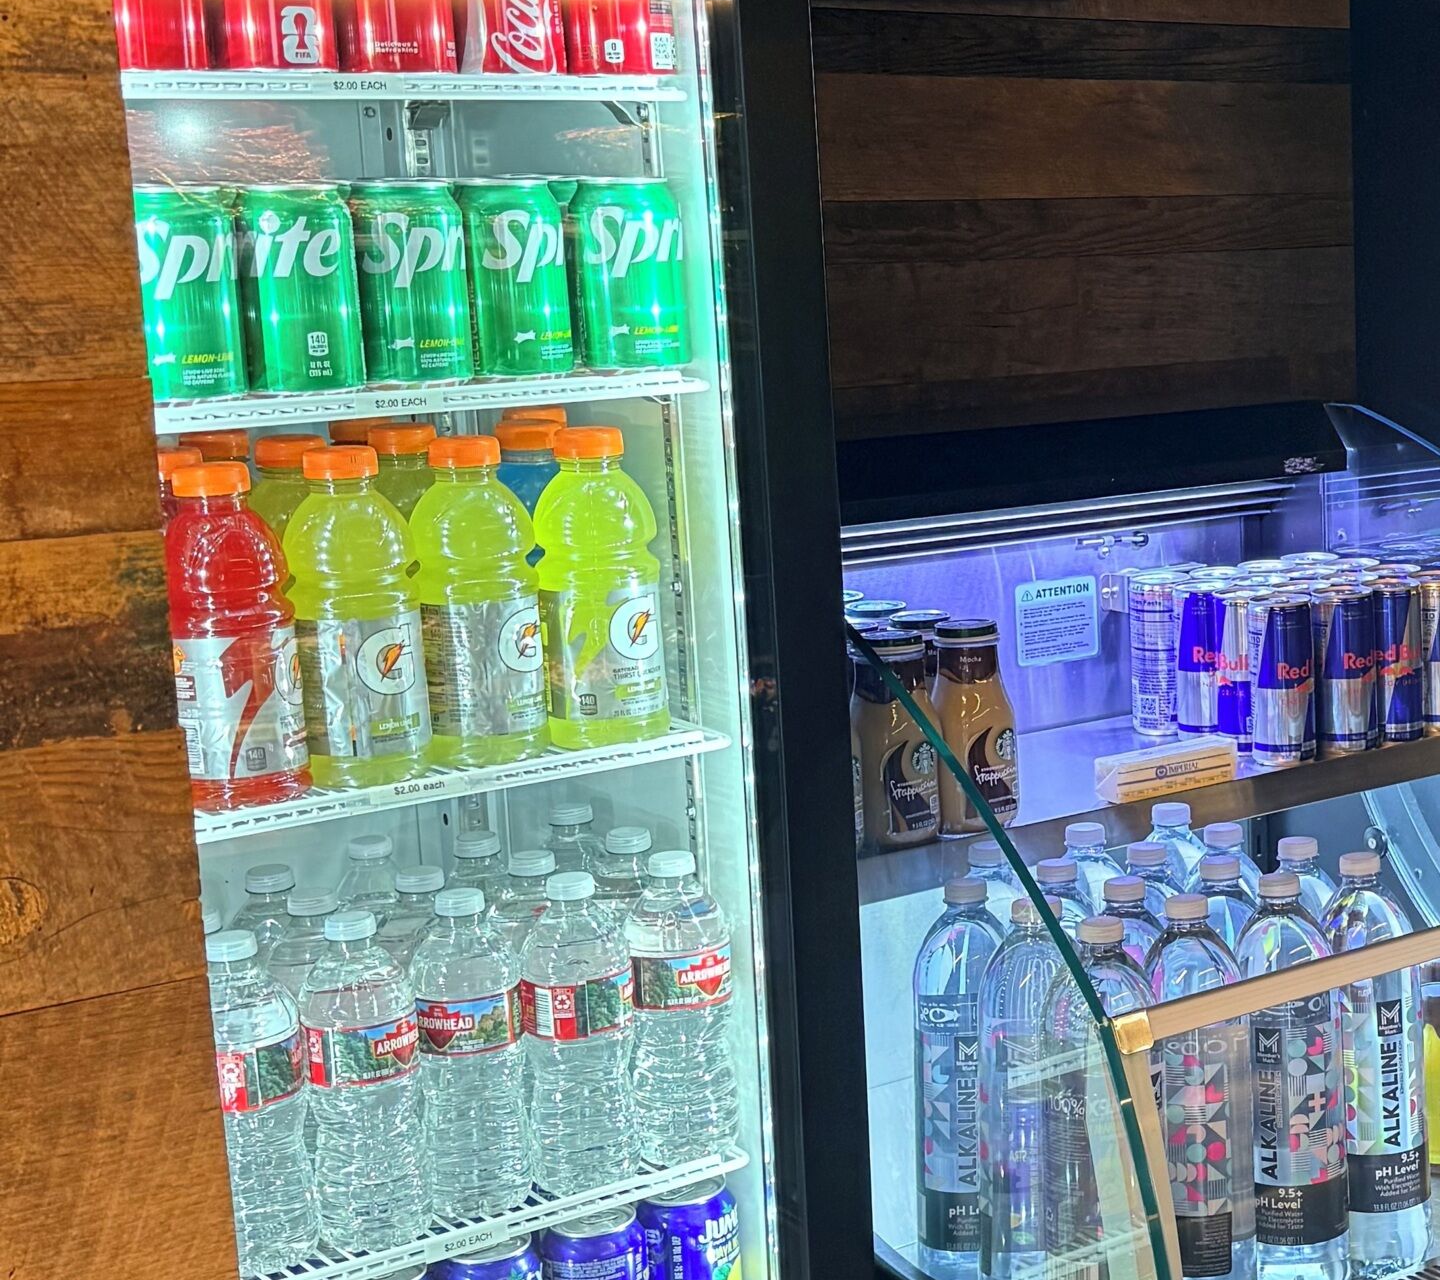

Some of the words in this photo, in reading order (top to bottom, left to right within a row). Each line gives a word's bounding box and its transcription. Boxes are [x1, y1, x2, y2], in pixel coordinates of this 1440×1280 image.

[295, 50, 312, 59] FIFA
[333, 80, 358, 91] $2.00
[360, 79, 388, 91] EACH
[310, 334, 326, 344] 140
[375, 397, 399, 408] $2.00
[401, 396, 428, 407] EACH
[1036, 582, 1089, 599] ATTENTION
[959, 655, 982, 664] Mocha
[1343, 649, 1374, 670] Red
[1276, 658, 1310, 680] Red
[393, 784, 421, 796] $2.00
[423, 779, 446, 792] each
[1380, 1039, 1401, 1148] ALKALINE
[1048, 1095, 1087, 1115] 100%
[955, 1077, 977, 1188] ALKALINE
[1258, 1069, 1279, 1181] ALKALINE
[1400, 1153, 1420, 1163] 9.5+
[1375, 1168, 1392, 1181] pH
[1393, 1161, 1420, 1176] Level
[1278, 1188, 1303, 1199] 9.5+
[1271, 1197, 1302, 1209] Level
[949, 1207, 966, 1218] pH
[443, 1239, 467, 1251] $2.00
[469, 1231, 494, 1247] EACH
